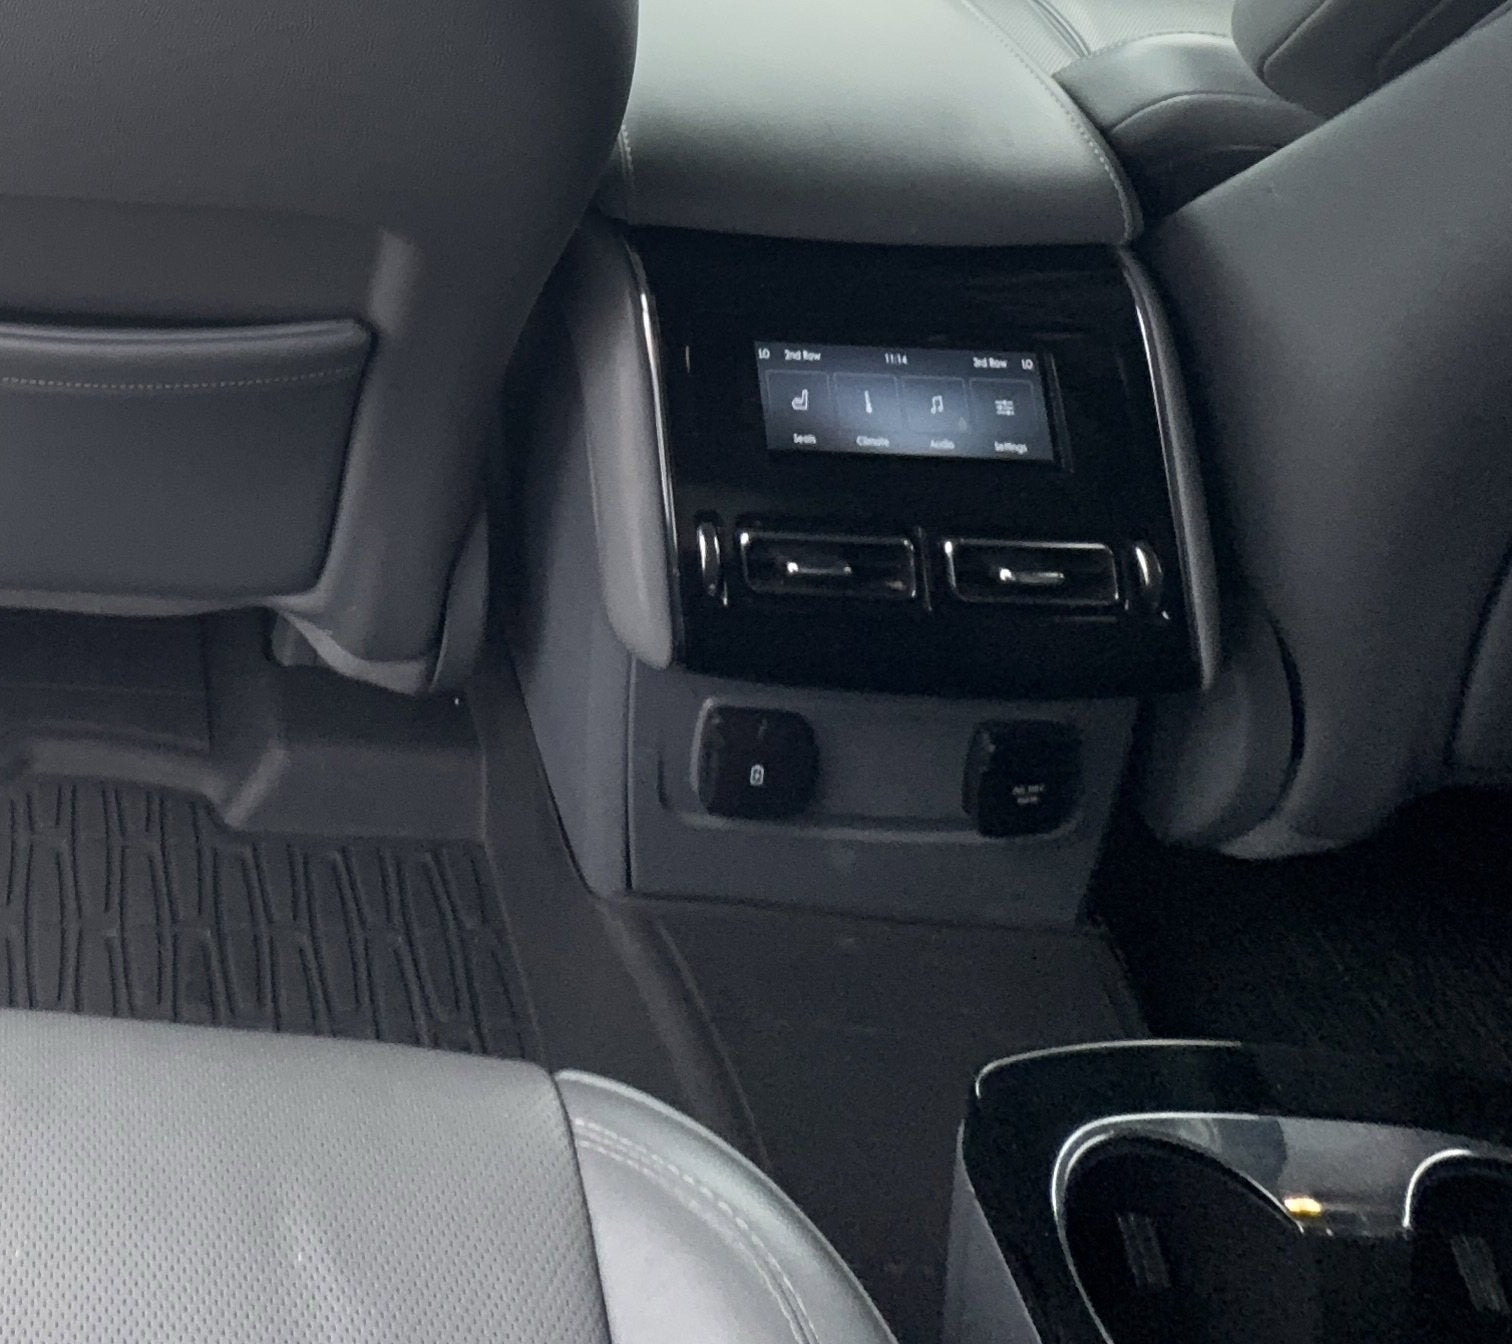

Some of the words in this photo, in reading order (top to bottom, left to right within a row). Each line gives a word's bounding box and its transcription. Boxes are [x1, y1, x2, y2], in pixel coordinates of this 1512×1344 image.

[758, 348, 771, 360] LO
[784, 348, 801, 361] 2nd
[802, 349, 821, 361] Row
[884, 352, 908, 365] 11:14
[972, 356, 988, 369] 3rd
[988, 356, 1008, 369] Row
[1021, 357, 1034, 370] LO
[792, 432, 817, 445] Seats
[855, 434, 890, 448] Climate
[929, 438, 956, 451] Audio
[994, 440, 1029, 455] Settings
